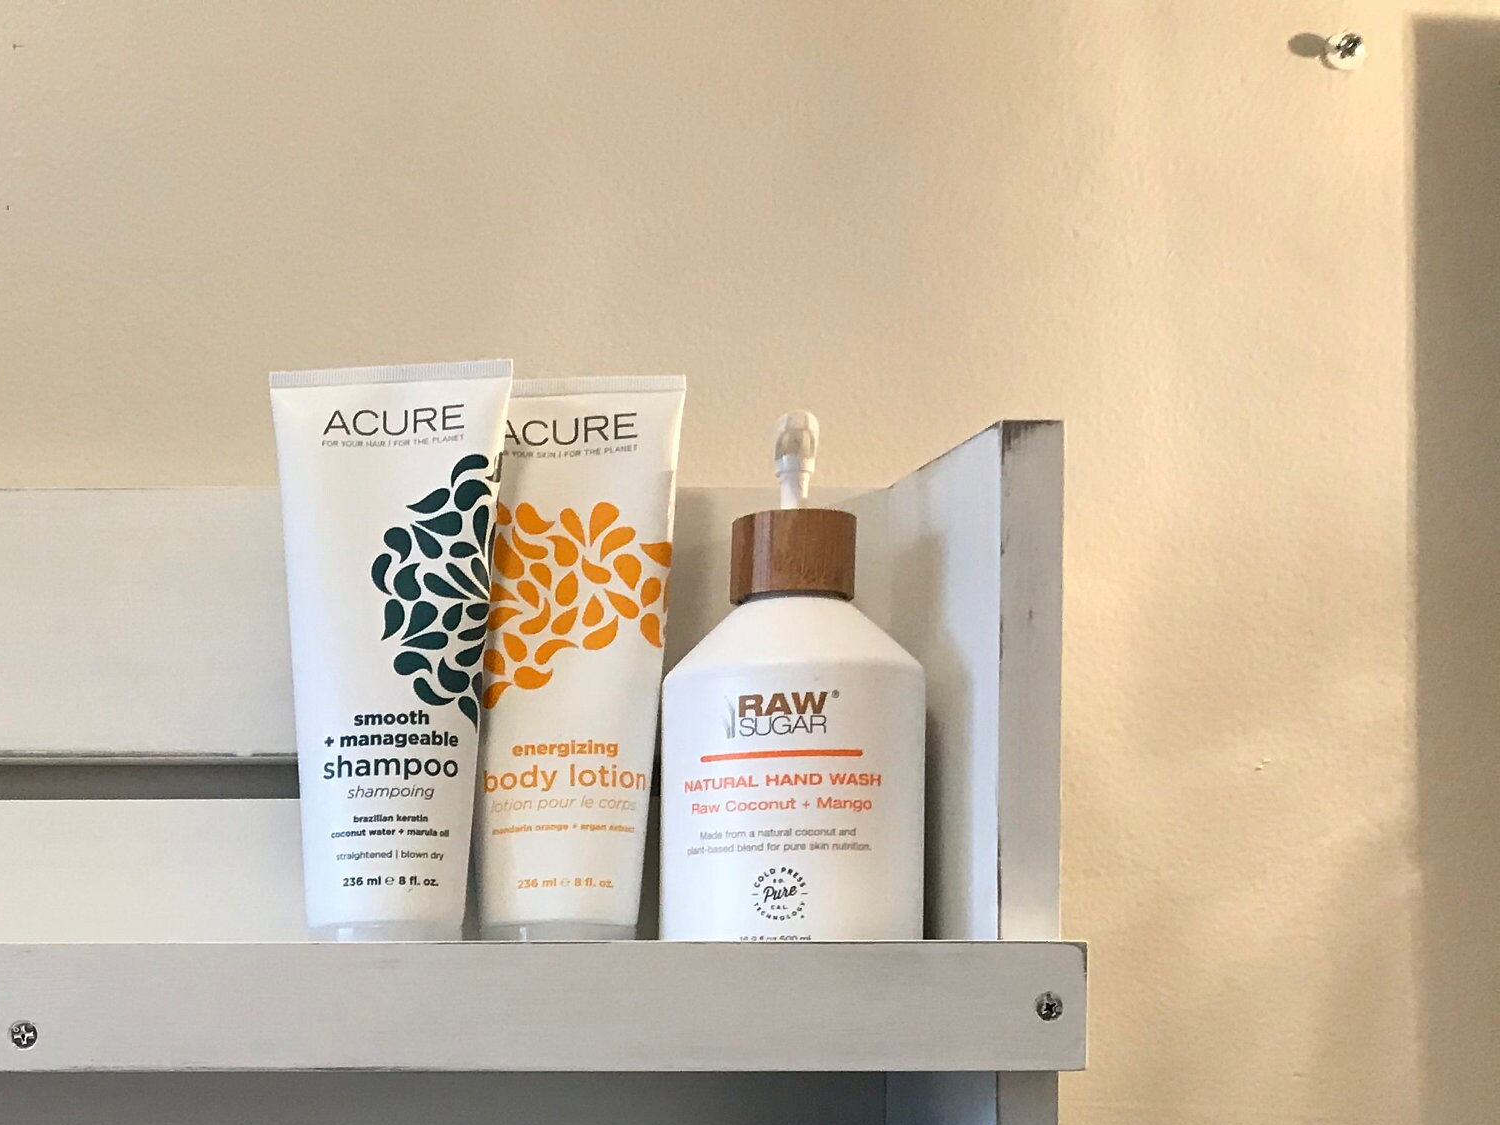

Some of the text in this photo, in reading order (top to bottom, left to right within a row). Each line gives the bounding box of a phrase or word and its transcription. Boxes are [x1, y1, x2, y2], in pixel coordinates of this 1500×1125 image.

[323, 404, 465, 436] ACURE
[413, 438, 429, 446] THE
[432, 434, 464, 444] PLANET
[585, 448, 601, 456] THE
[604, 444, 638, 454] PLANET
[354, 710, 430, 726] smooth
[739, 714, 828, 737] SUGAR
[340, 731, 459, 748] manageable
[512, 740, 618, 757] energizing
[323, 755, 459, 780] shampoo
[484, 764, 646, 793] body lotion
[684, 773, 881, 793] NATURAL HAND WASH
[347, 785, 435, 800] shampoing
[491, 795, 637, 813] lotion pour le corps
[692, 803, 720, 814] Raw
[725, 798, 796, 812] Coconut
[817, 797, 872, 812] Mango
[353, 814, 429, 823] brazilian keratin
[331, 829, 366, 838] coconut
[407, 829, 437, 837] marula
[439, 829, 449, 837] oil
[535, 823, 568, 832] orange
[700, 831, 722, 840] Made
[725, 830, 746, 839] from
[758, 829, 792, 838] natural
[795, 828, 836, 837] coconut
[838, 828, 856, 837] and
[737, 843, 764, 852] blend
[767, 842, 781, 851] for
[783, 843, 806, 853] pure
[809, 842, 829, 851] skin
[336, 851, 392, 861] straightened
[400, 851, 428, 859] blown
[430, 852, 444, 861] dry
[343, 877, 363, 887] 236
[367, 875, 381, 886] ml
[399, 876, 406, 886] 8
[423, 878, 439, 887] oz.
[517, 878, 538, 889] 236
[542, 878, 557, 888] ml
[574, 877, 582, 887] 8
[753, 866, 807, 889] COLD PRESS
[763, 885, 798, 903] Pure
[753, 900, 806, 921] TECHNOLOGY
